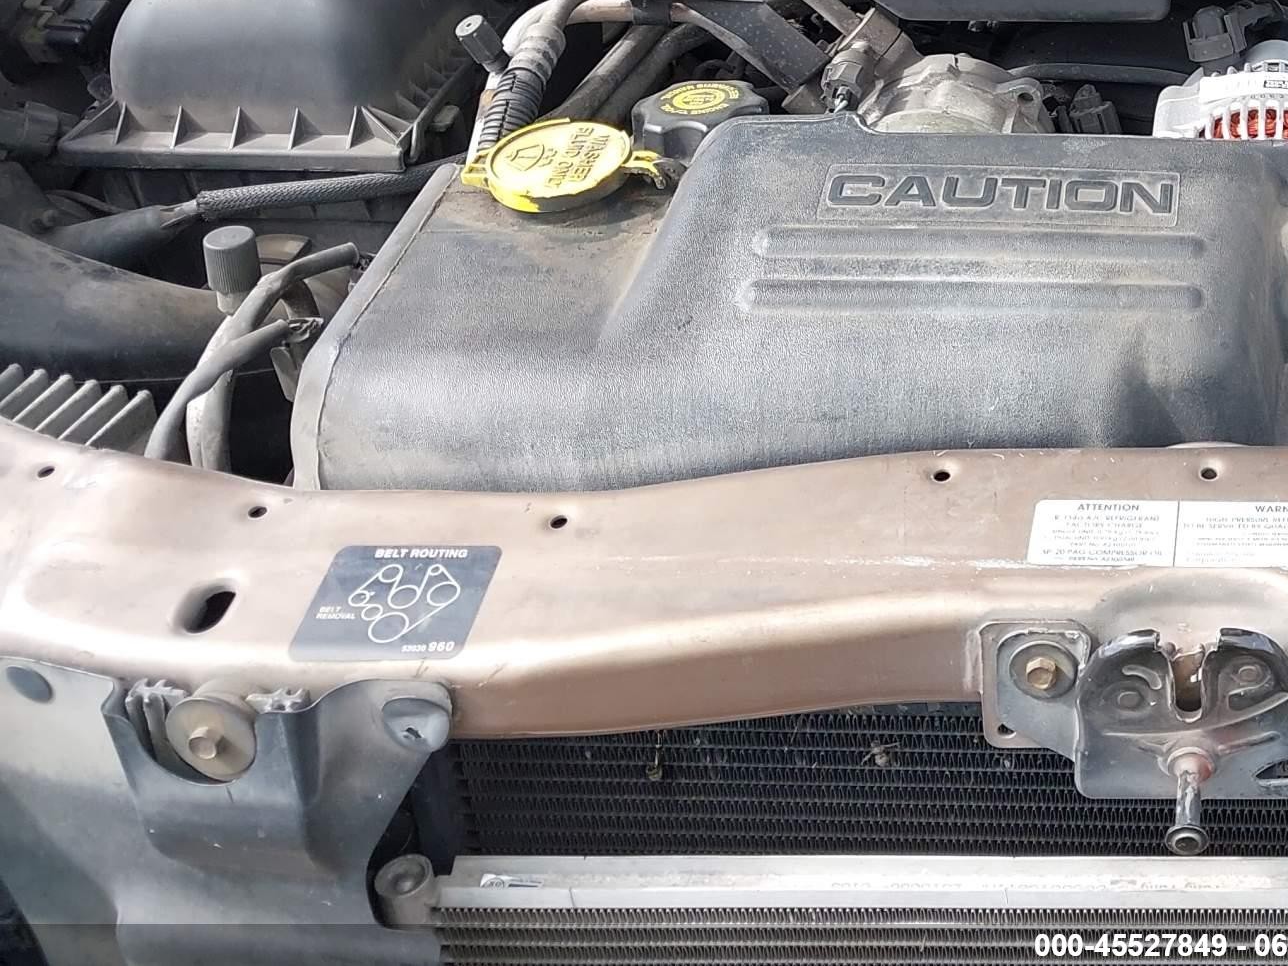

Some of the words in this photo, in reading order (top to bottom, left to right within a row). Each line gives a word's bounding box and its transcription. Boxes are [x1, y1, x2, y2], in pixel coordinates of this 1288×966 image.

[827, 172, 1174, 214] CAUTION
[1077, 503, 1140, 511] ATTENTION
[374, 549, 409, 559] BELT
[410, 548, 469, 559] ROUTING
[315, 612, 356, 620] REMOVAL
[427, 641, 455, 652] 960
